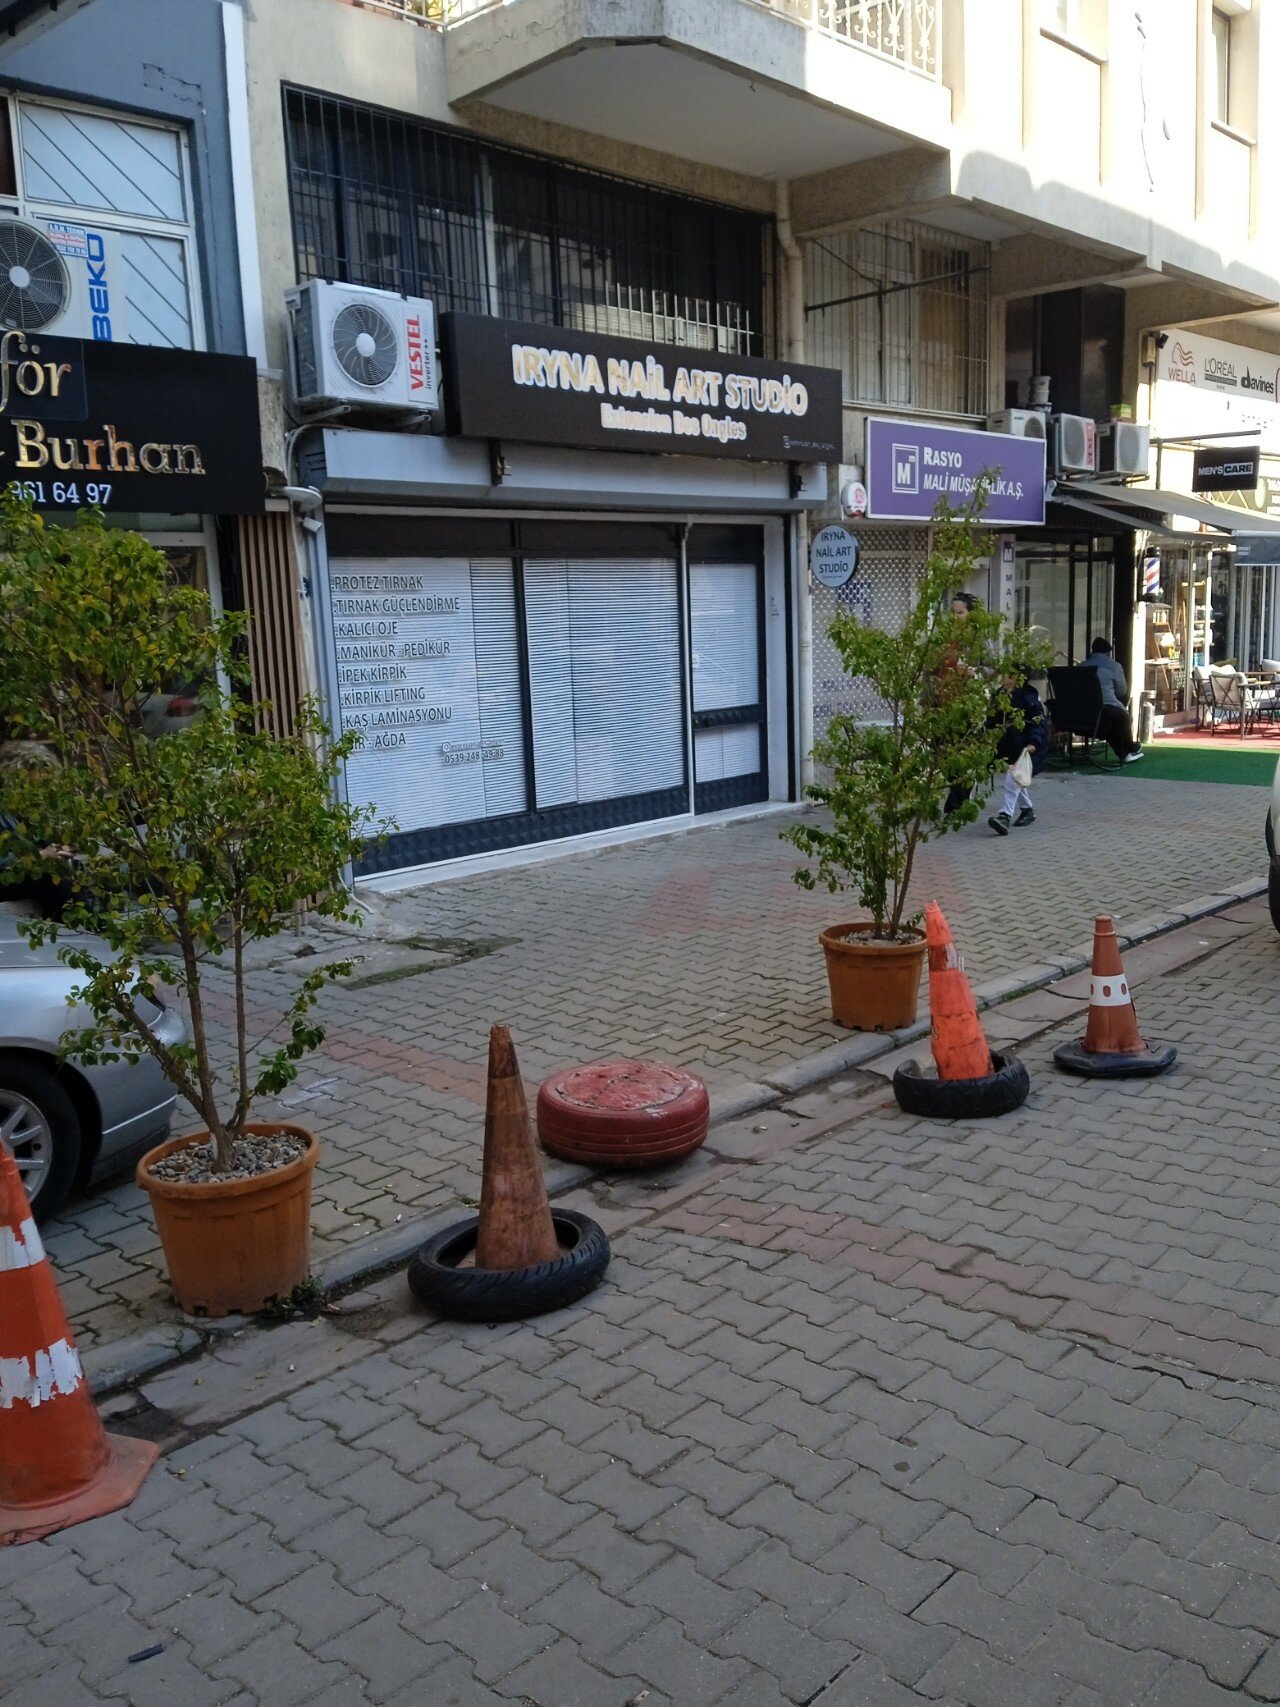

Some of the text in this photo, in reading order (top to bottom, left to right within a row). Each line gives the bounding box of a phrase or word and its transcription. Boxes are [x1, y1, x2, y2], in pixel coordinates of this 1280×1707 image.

[86, 233, 112, 341] BEKO
[406, 314, 424, 390] VESTEL
[511, 344, 605, 393] IRYNA
[673, 367, 723, 407] ART
[1168, 367, 1196, 384] WELLA
[1241, 366, 1274, 394] davines
[701, 413, 747, 443] Ongles
[11, 419, 206, 475] Burhan
[53, 482, 79, 503] 64
[86, 483, 112, 504] 97
[923, 472, 948, 490] MALİ
[1007, 482, 1023, 500] A.Ş.
[835, 546, 852, 556] ART
[382, 576, 423, 589] TIRNAK
[382, 594, 460, 616] GÜÇLENDİRME
[378, 621, 398, 635] OJE
[404, 639, 450, 656] PEDİKÜR
[370, 662, 407, 679] KİRPİK
[384, 687, 426, 703] LIFTING
[371, 707, 452, 726] LAMİNASYONU
[374, 731, 407, 748] AĞDA
[445, 753, 464, 764] 0539
